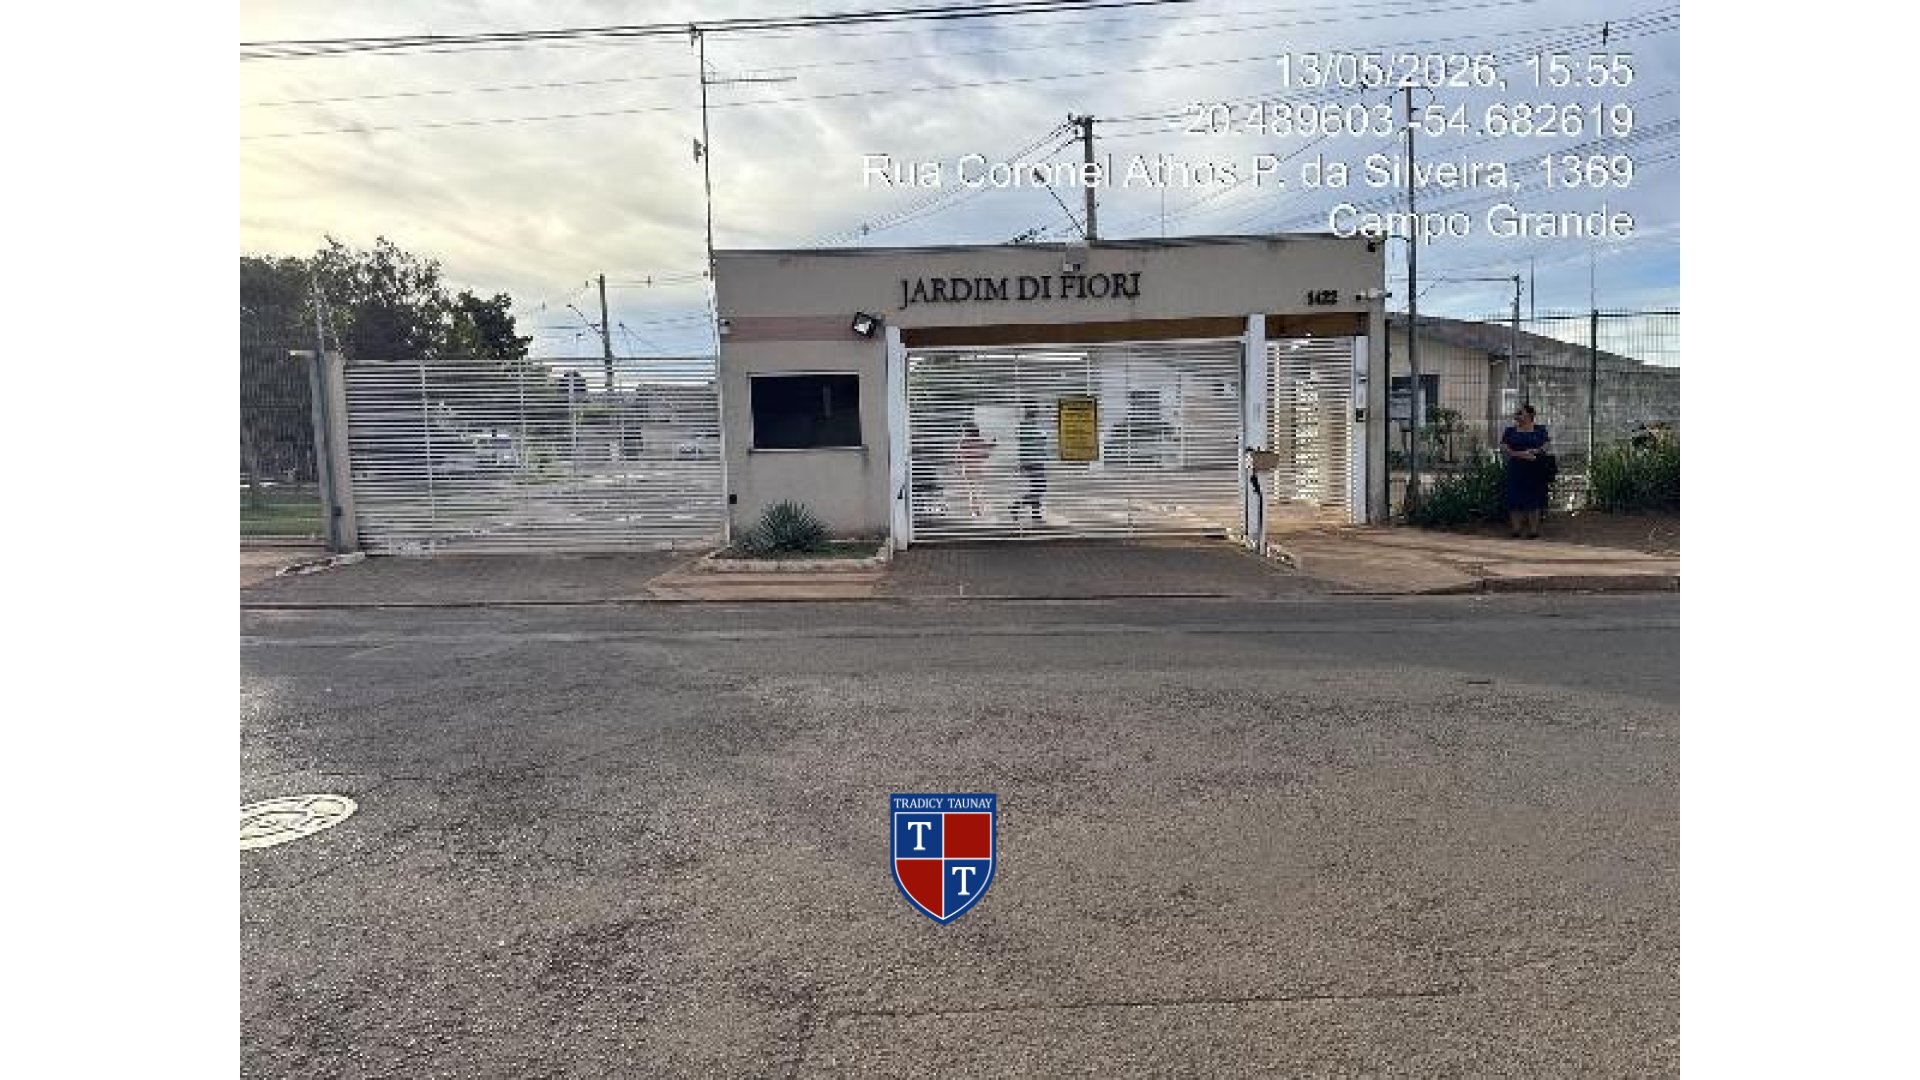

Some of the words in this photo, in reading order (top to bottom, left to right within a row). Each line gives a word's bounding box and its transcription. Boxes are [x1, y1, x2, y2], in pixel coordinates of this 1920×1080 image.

[898, 277, 1009, 310] JARDIM
[1017, 275, 1052, 300] DI
[1060, 272, 1140, 298] FIORI
